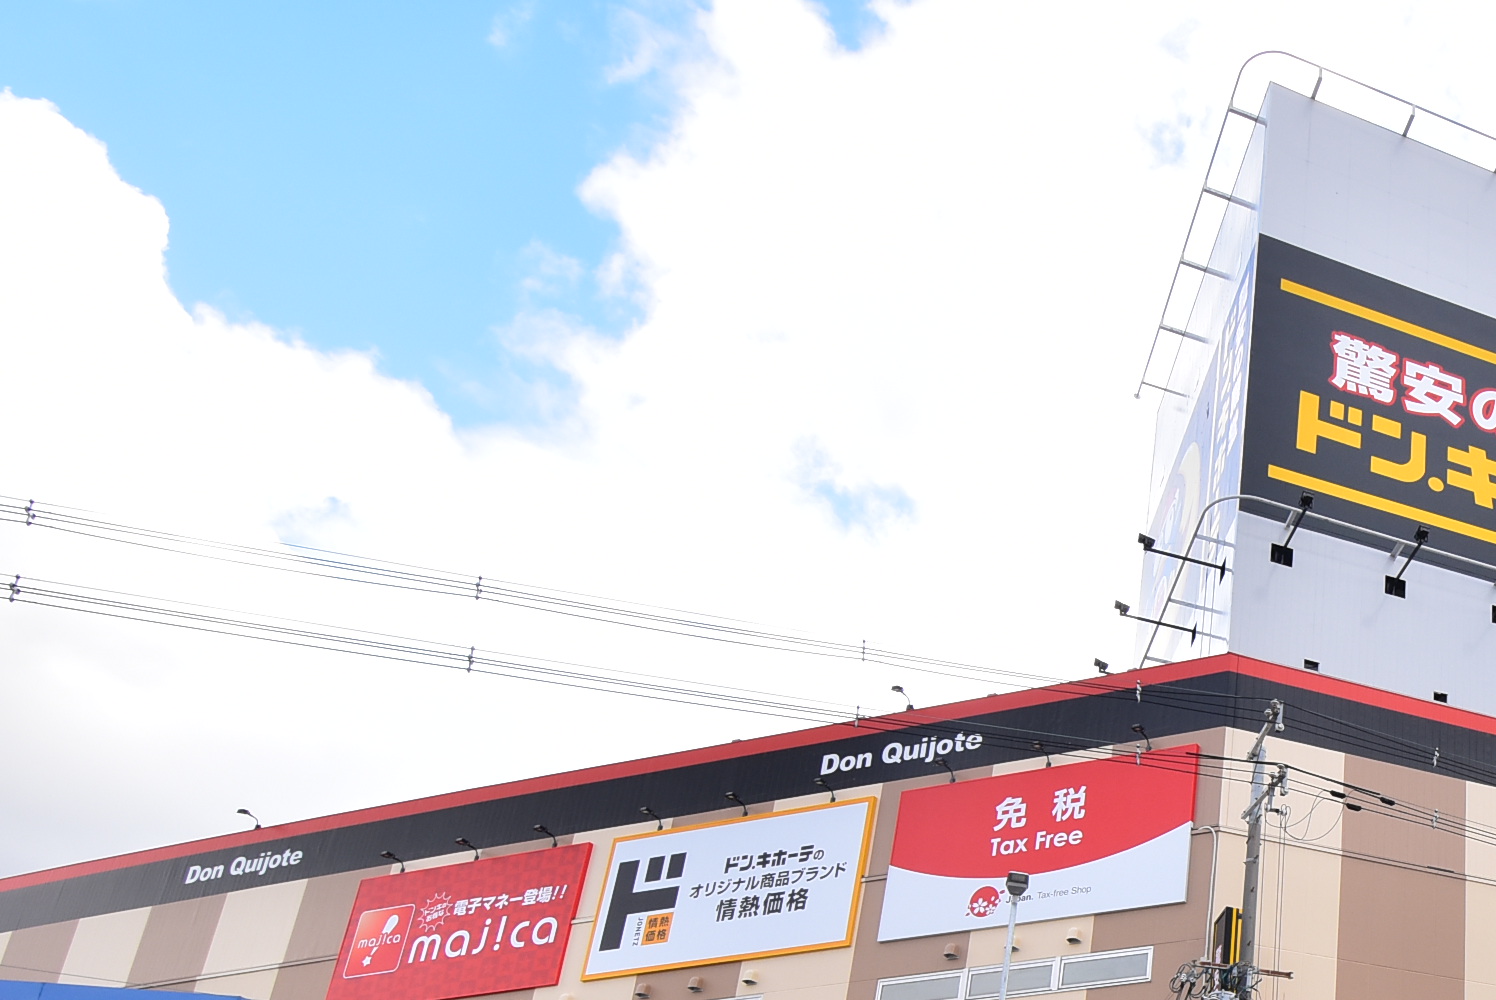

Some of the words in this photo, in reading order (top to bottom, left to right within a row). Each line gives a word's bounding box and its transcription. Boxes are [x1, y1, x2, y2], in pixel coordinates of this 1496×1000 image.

[820, 752, 873, 776] Don
[881, 731, 983, 764] Quijote
[993, 785, 1087, 831] 免税
[990, 837, 1028, 857] Tax
[1034, 829, 1084, 850] Free
[184, 864, 225, 885] Don
[229, 848, 304, 876] Quijote
[688, 861, 848, 899] オリジナル商品ブランド
[453, 884, 568, 917] 電子マネー登場!!
[715, 887, 809, 923] 情熱価格
[1037, 889, 1069, 900] Tax-free
[1070, 885, 1093, 896] Shop
[631, 917, 644, 947] JONETZ
[645, 928, 667, 942] 価格
[648, 916, 670, 929] 情熱
